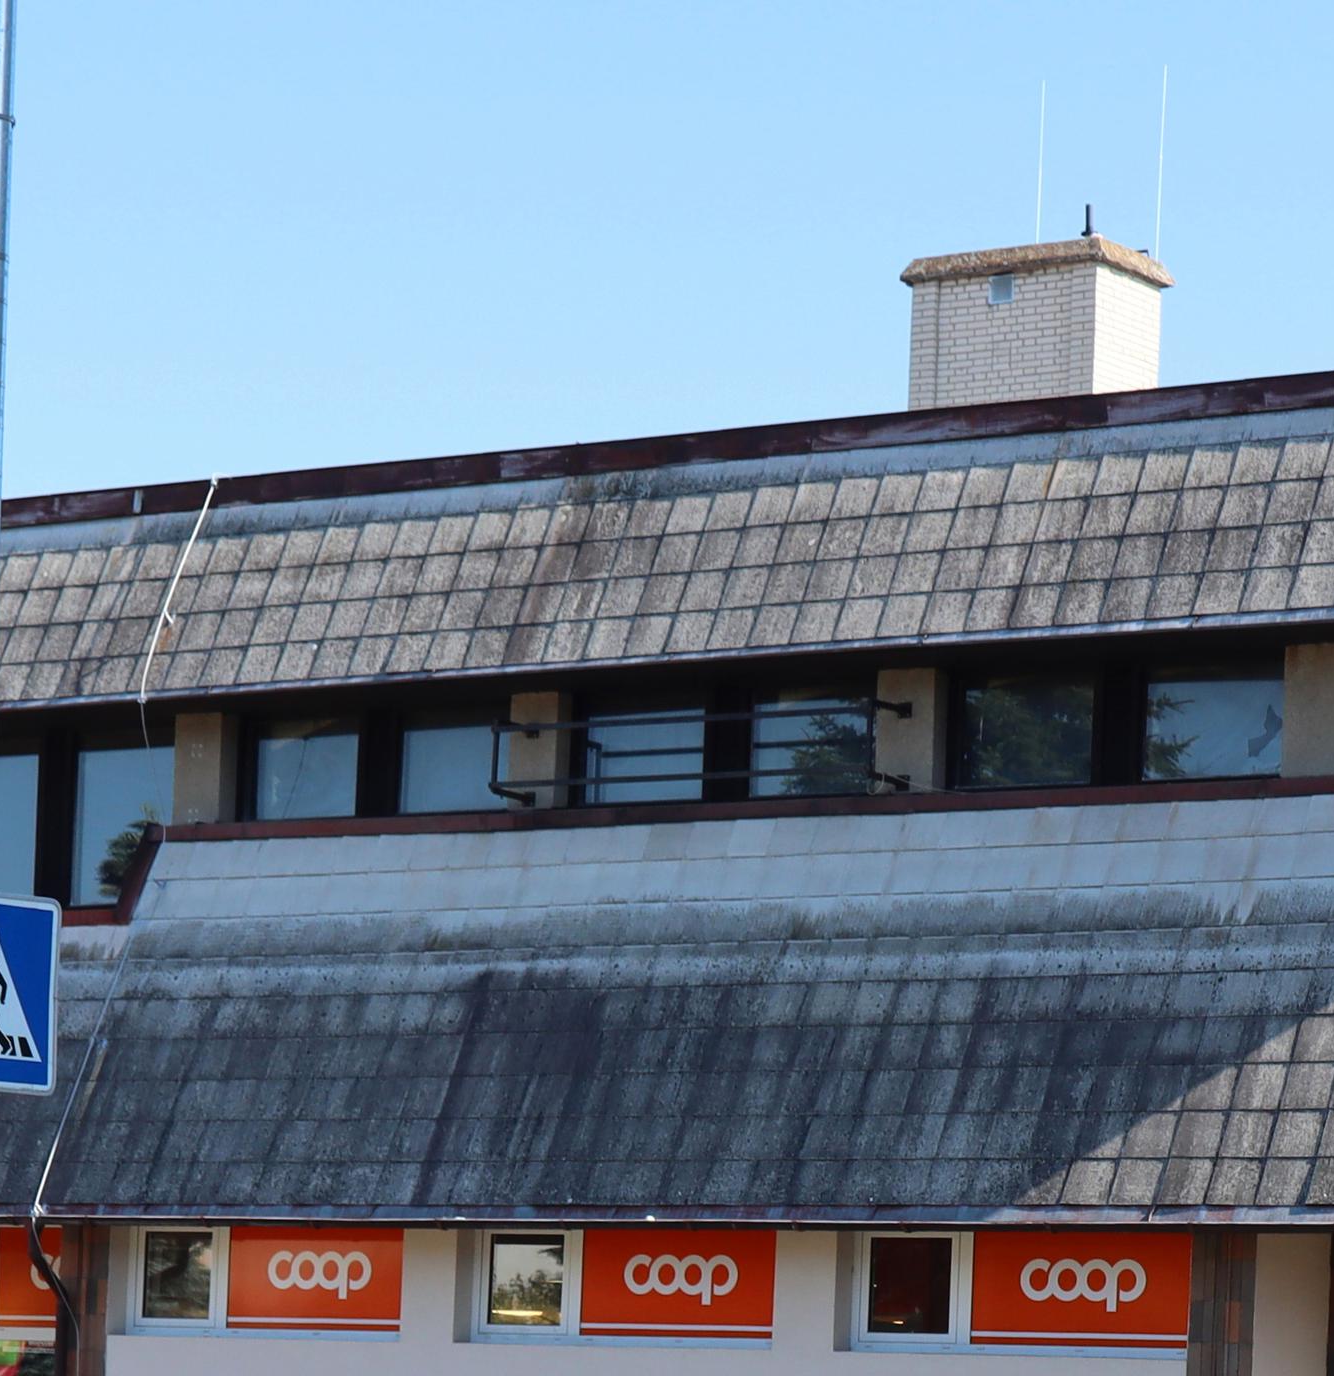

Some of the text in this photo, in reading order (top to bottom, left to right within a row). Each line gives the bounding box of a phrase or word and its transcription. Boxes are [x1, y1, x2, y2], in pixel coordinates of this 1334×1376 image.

[268, 1250, 372, 1300] coop
[624, 1254, 738, 1305] coop
[1020, 1258, 1146, 1312] coop
